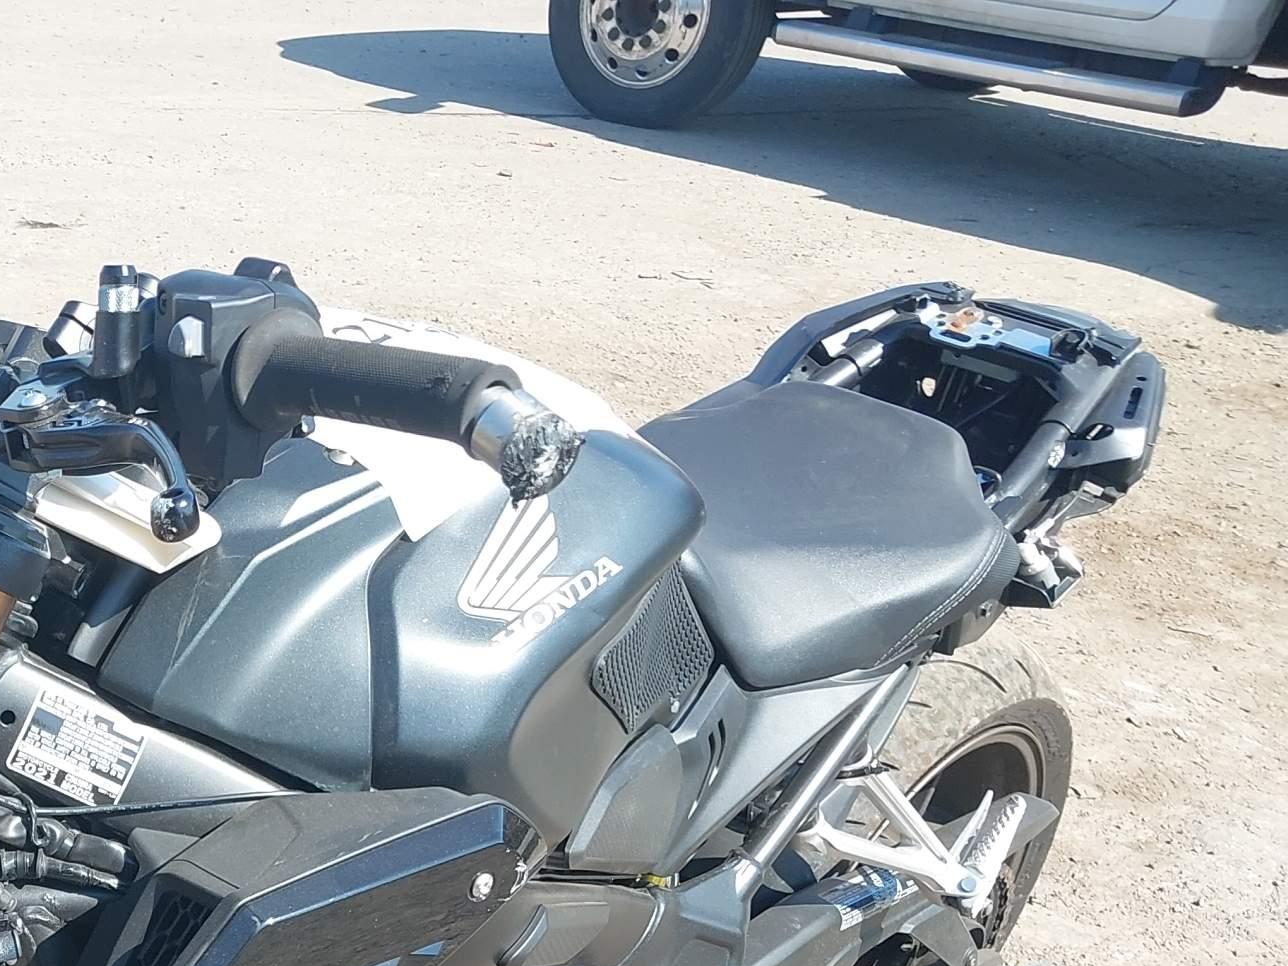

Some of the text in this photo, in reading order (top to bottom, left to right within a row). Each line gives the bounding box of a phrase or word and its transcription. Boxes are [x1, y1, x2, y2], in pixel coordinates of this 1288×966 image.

[489, 555, 624, 654] HONDA
[11, 757, 57, 785] 2021
[60, 779, 94, 803] MODEL
